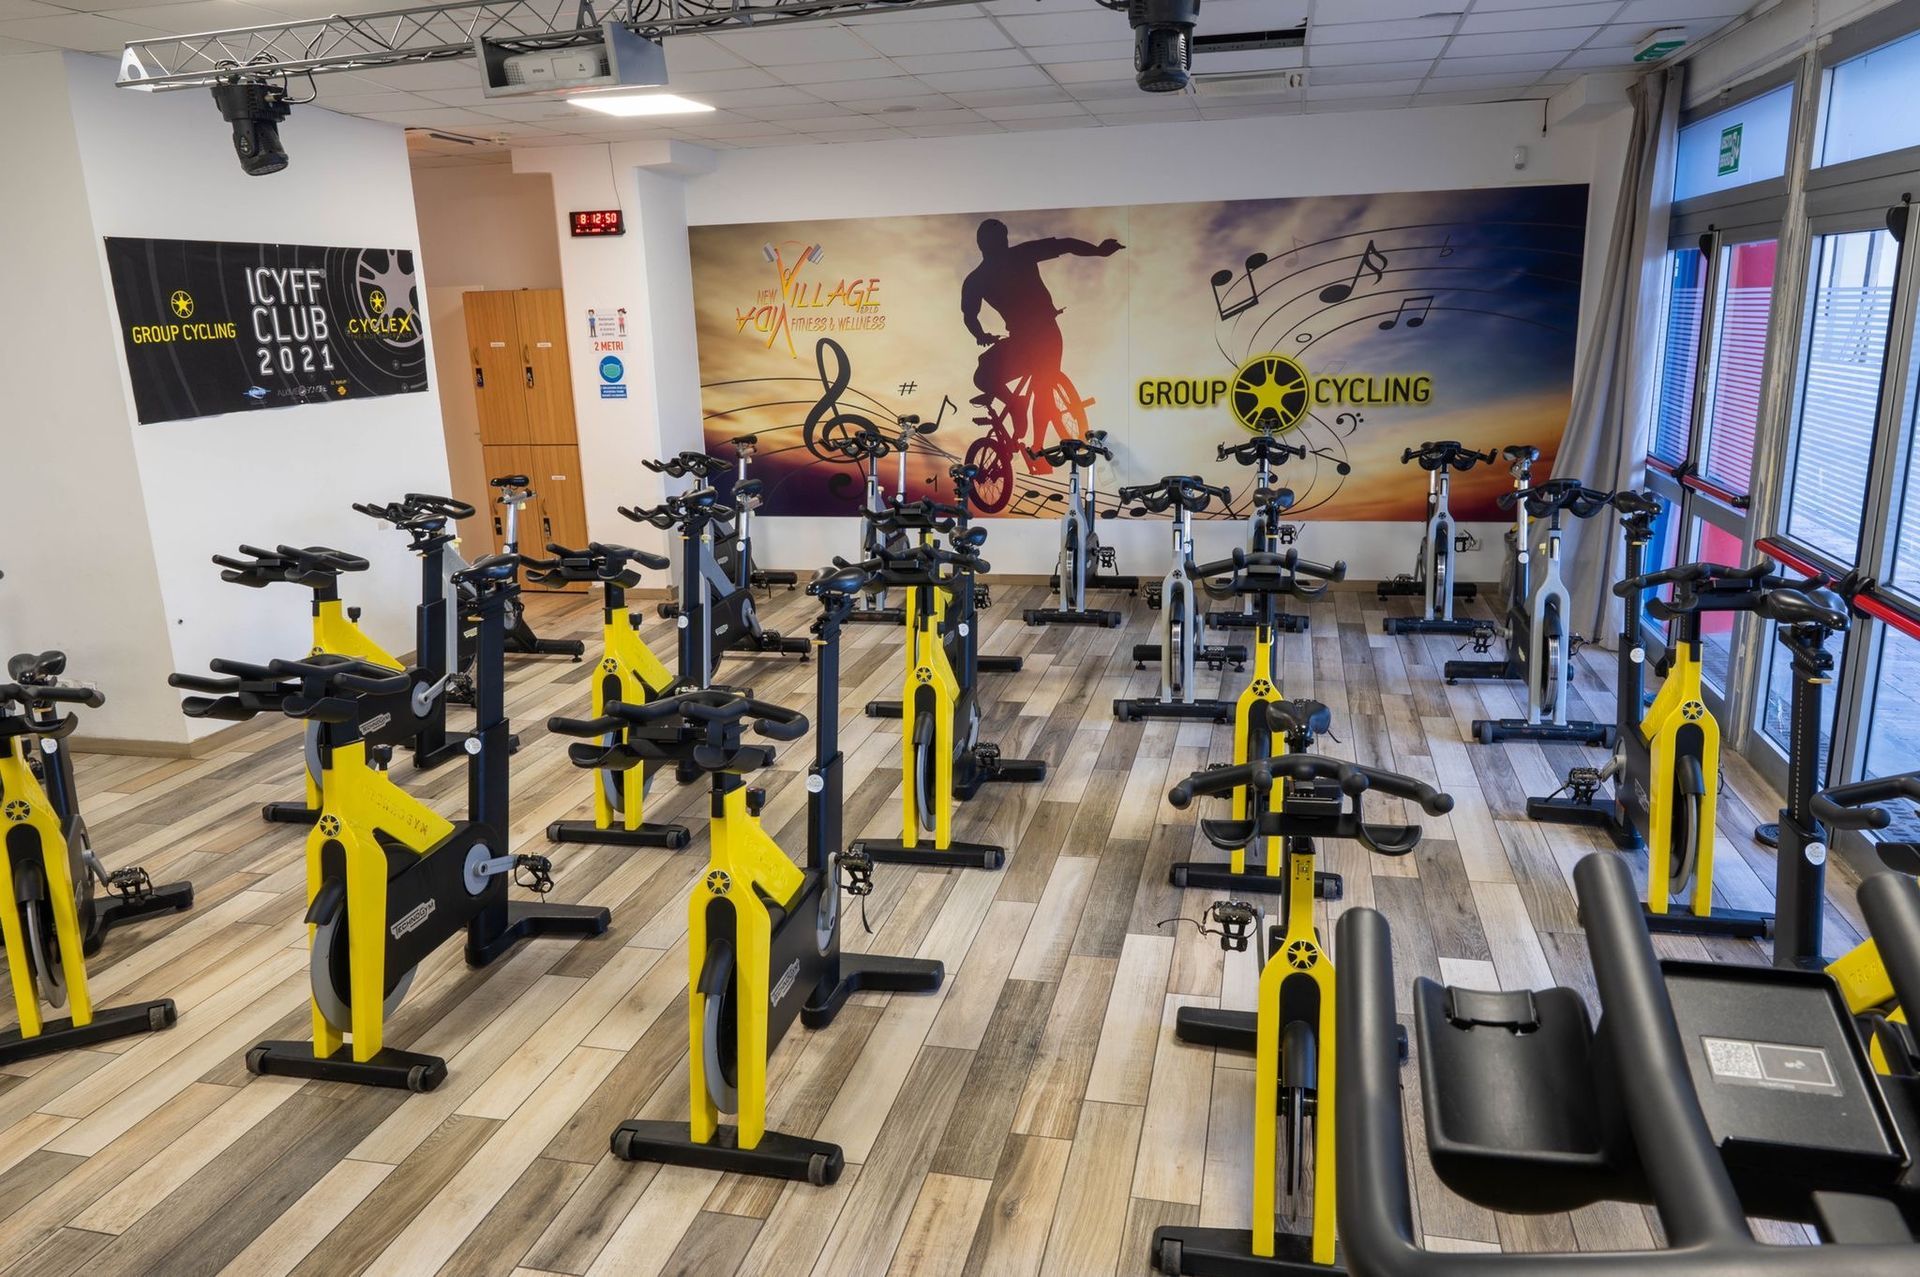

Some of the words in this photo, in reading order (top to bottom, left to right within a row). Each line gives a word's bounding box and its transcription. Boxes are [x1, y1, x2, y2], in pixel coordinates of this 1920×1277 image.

[580, 213, 617, 224] 8:12:50
[245, 267, 322, 305] ICYFF
[757, 288, 778, 304] NEW
[132, 324, 180, 344] GROUP
[182, 322, 236, 341] CYCLING
[252, 305, 330, 344] CLUB
[348, 313, 413, 338] CYCLEX
[791, 317, 827, 331] FITNESS
[838, 316, 886, 331] WELLNESS
[594, 342, 599, 351] 2
[601, 341, 624, 352] METRI
[258, 344, 334, 376] 2021
[1138, 380, 1228, 405] GROUP
[1314, 376, 1432, 403] CYCLING
[392, 899, 435, 938] TECHNOGYM
